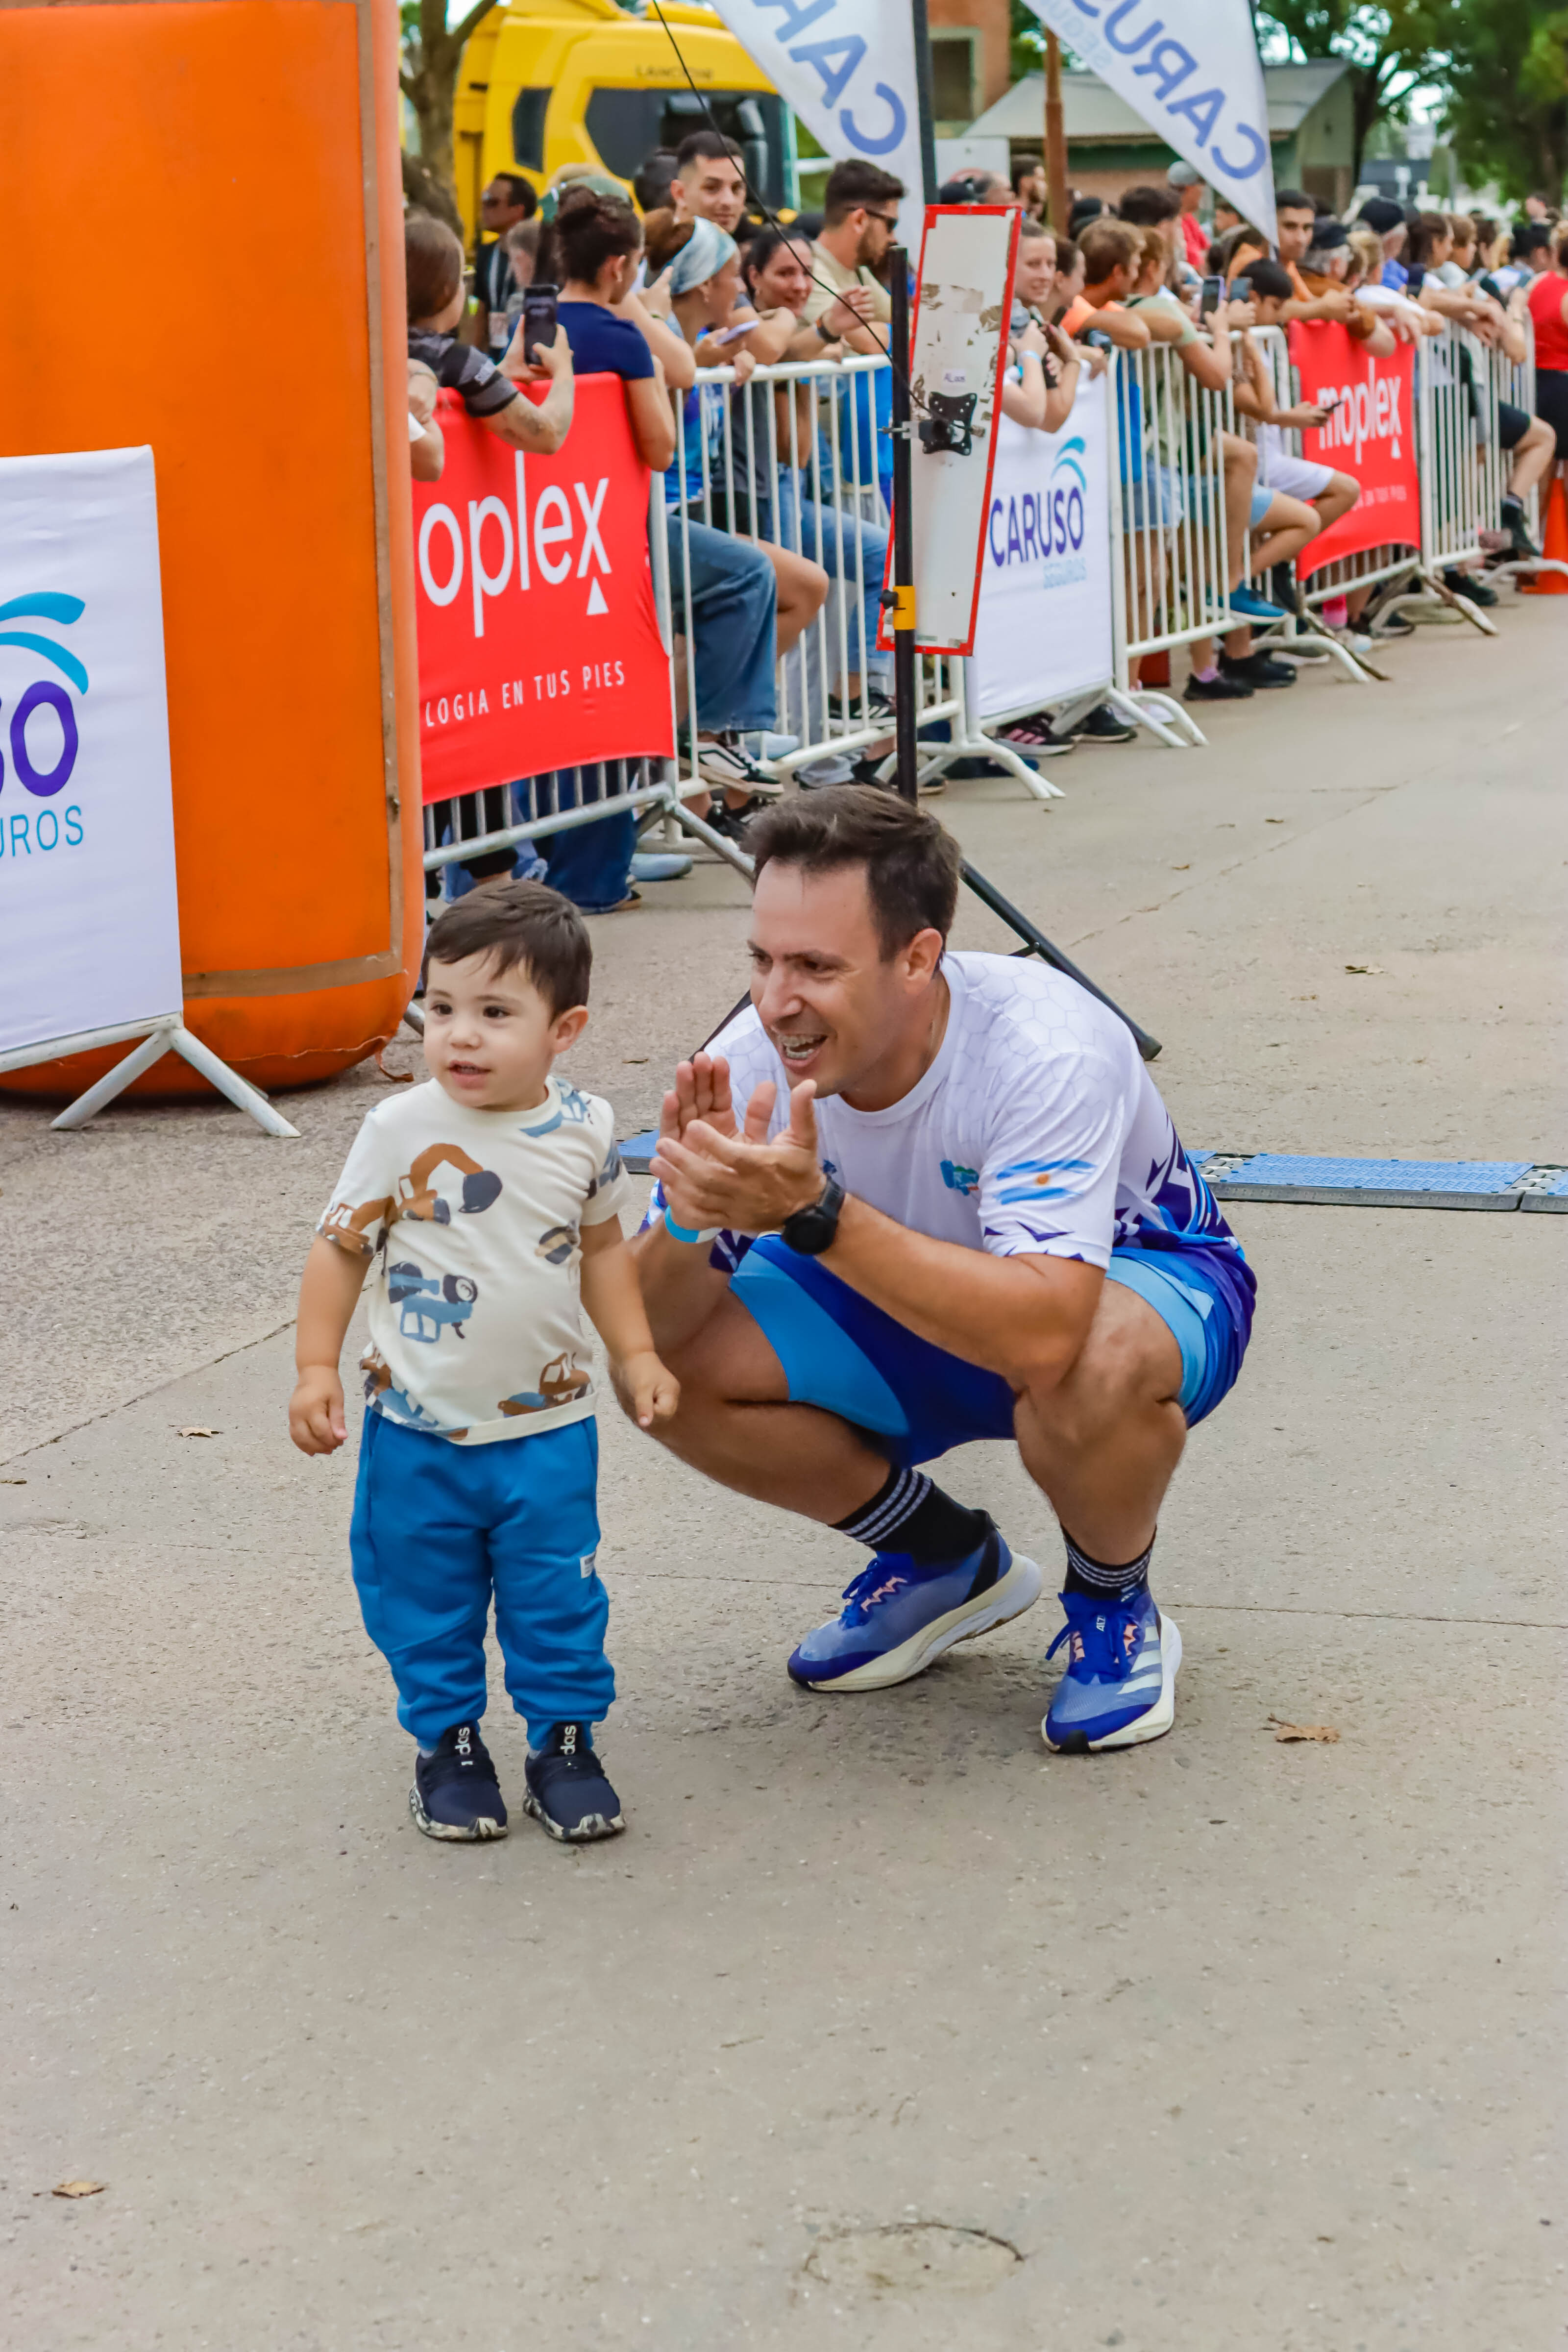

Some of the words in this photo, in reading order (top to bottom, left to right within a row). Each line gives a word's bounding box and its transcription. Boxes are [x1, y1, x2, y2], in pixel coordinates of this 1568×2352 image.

[1317, 357, 1402, 465] moplex
[418, 449, 612, 638] oplex
[990, 486, 1084, 567] CARUSO
[0, 680, 78, 797] O
[425, 688, 490, 727] LOGIA
[502, 680, 524, 709] EN
[534, 669, 570, 701] TUS
[582, 660, 625, 690] PIES
